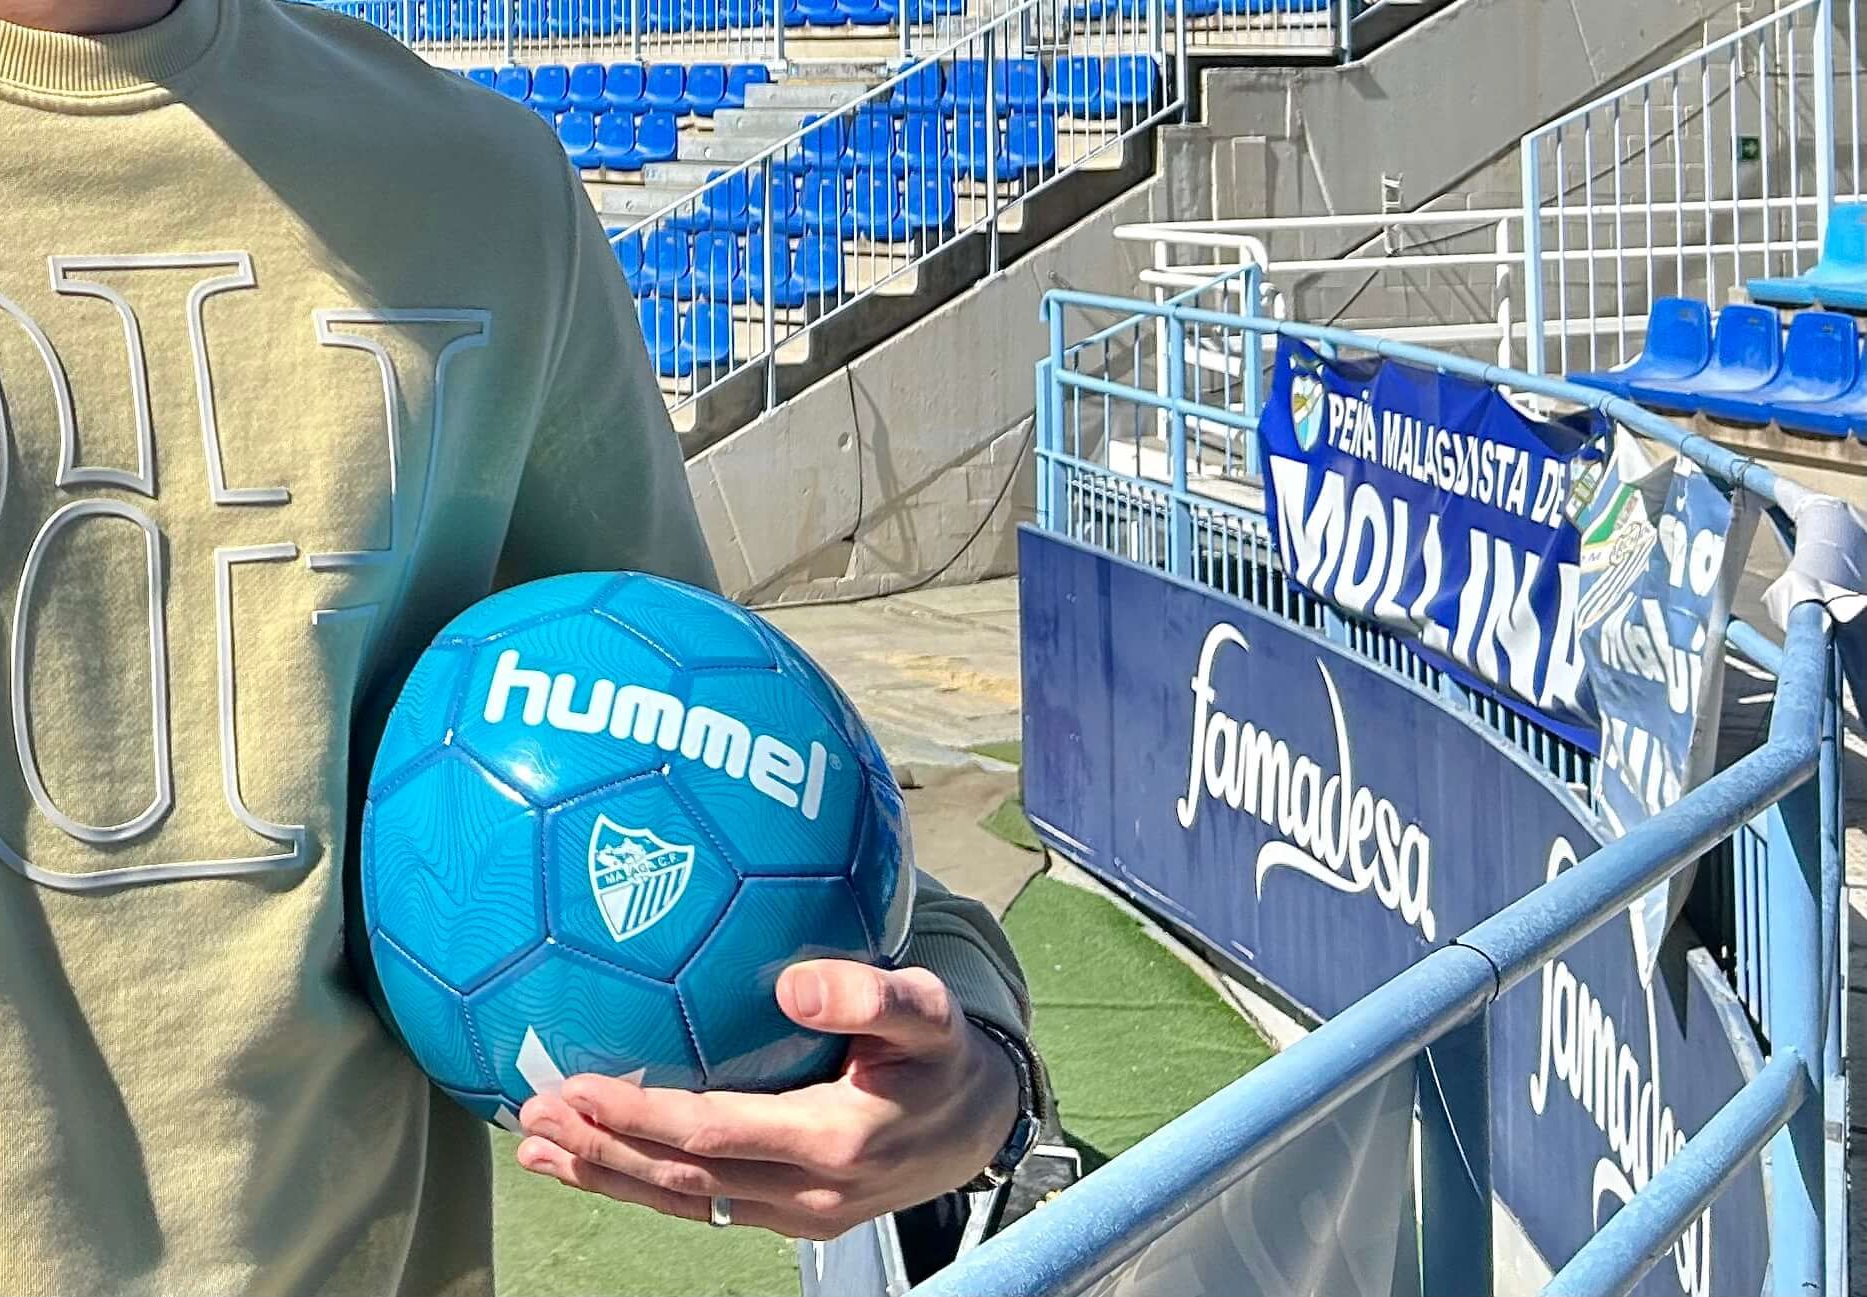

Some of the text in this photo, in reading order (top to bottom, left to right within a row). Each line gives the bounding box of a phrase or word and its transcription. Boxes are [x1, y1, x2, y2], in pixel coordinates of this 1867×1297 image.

[1328, 389, 1567, 526] PEÑA MALAGUISTA DE
[1270, 455, 1585, 709] MOLLINA
[485, 649, 826, 821] hummel
[1176, 622, 1437, 943] famadesa
